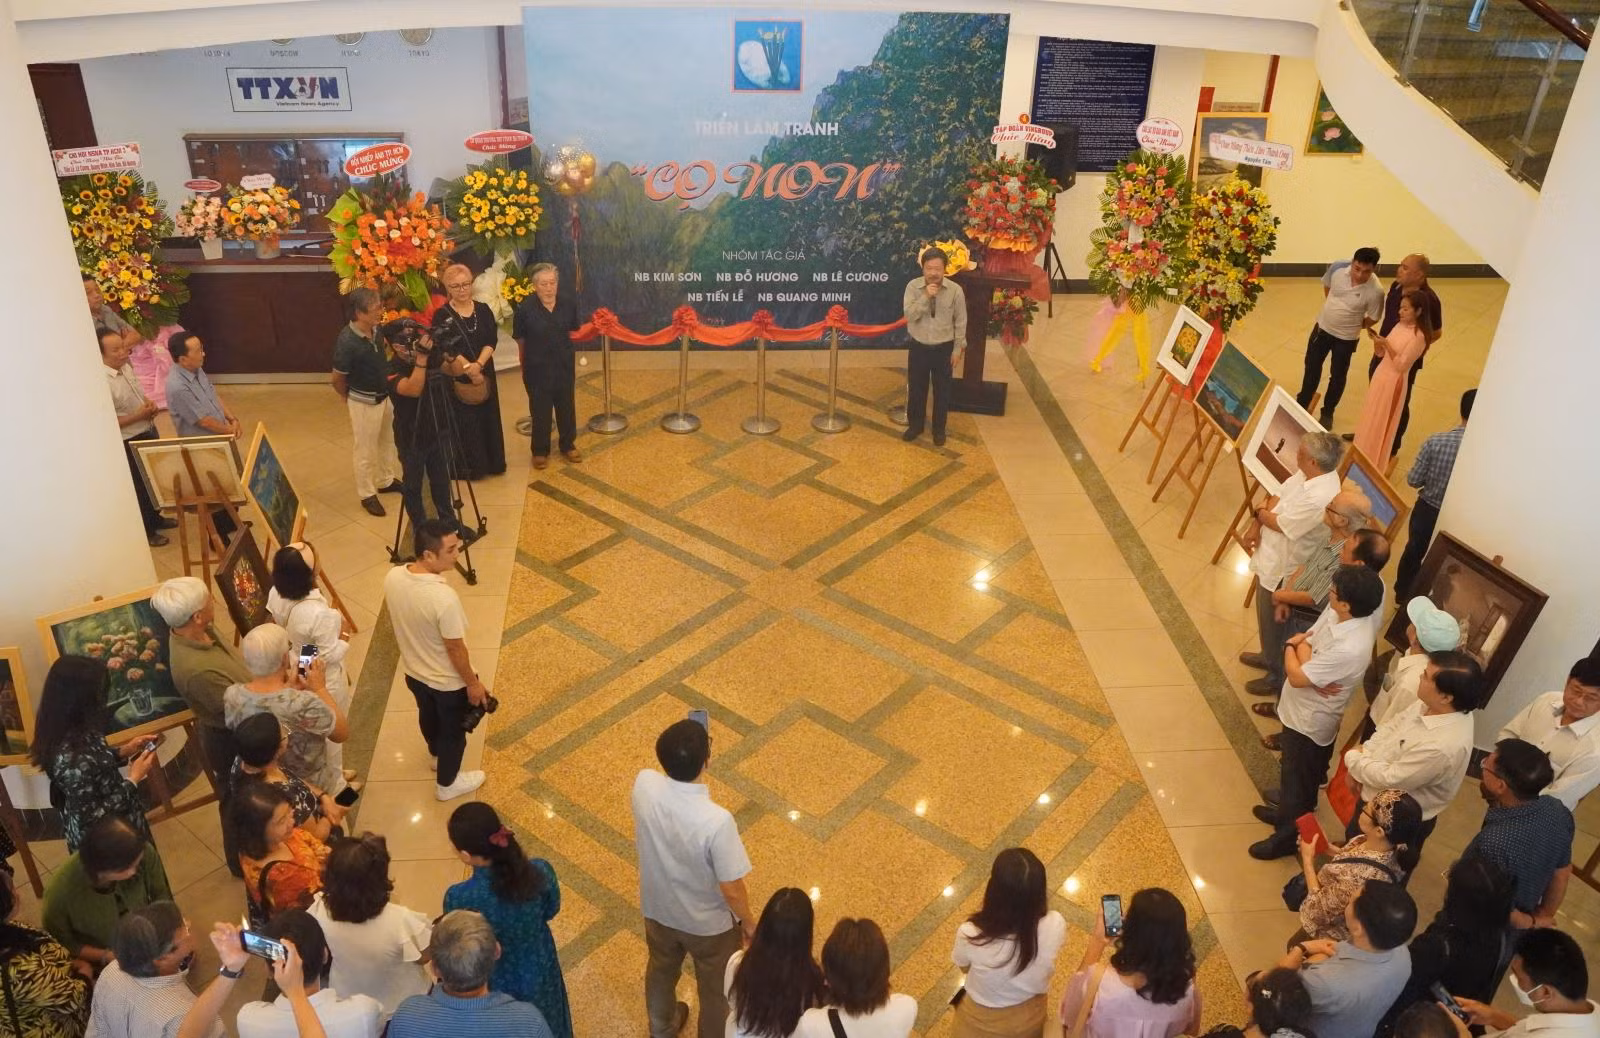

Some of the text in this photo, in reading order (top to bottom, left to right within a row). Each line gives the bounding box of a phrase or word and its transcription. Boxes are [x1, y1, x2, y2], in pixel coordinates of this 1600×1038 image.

[236, 76, 340, 100] TTXVN
[784, 122, 839, 136] TRANH
[354, 156, 404, 175] CHÚC MỪNG
[722, 249, 758, 260] NHÓM
[761, 248, 783, 260] TÁC
[634, 268, 889, 282] NB KIM SƠN NB ĐỖ HƯƠNG NB LÊ CƯƠNG
[688, 292, 703, 302] NB
[706, 289, 728, 302] TIẾN
[758, 292, 773, 302] NB
[776, 292, 818, 302] QUANG
[821, 292, 851, 302] MINH
